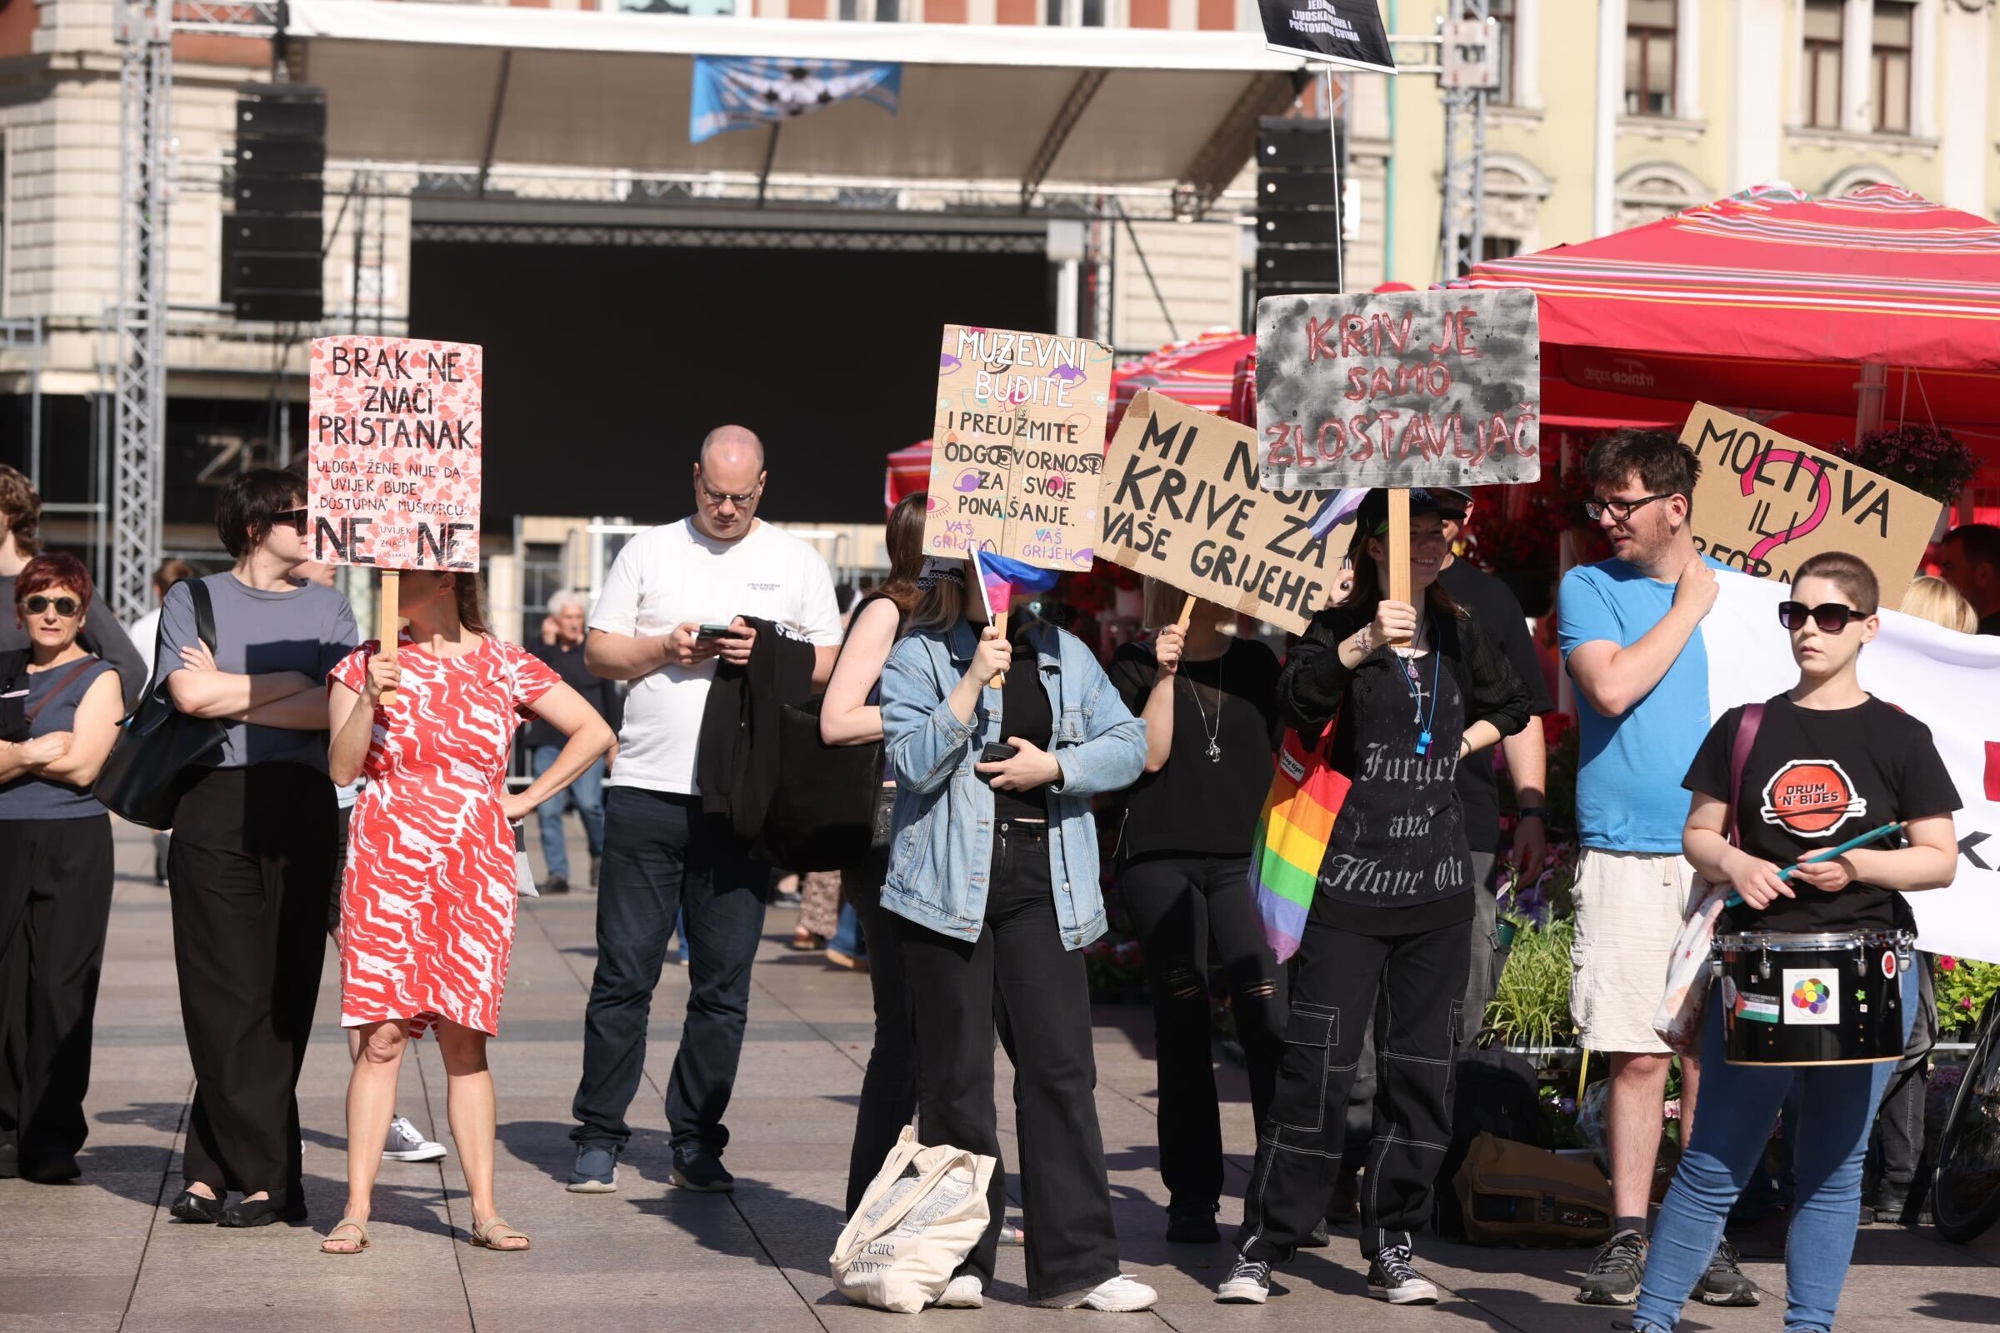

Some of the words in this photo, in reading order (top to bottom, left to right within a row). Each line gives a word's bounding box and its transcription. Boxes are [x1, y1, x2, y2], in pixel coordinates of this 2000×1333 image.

[956, 328, 1087, 371] MUŽEVNI
[1306, 310, 1413, 362] KRIV
[1429, 306, 1482, 358] JE
[332, 346, 413, 380] BRAK
[428, 352, 464, 383] NE
[1344, 359, 1453, 401] SAMO
[363, 382, 433, 415] ZNAČI
[975, 370, 1075, 408] BUDITE
[318, 415, 475, 450] PRISTANAK
[948, 411, 954, 430] I
[1138, 410, 1199, 466] MI
[1265, 401, 1537, 468] ZLOSTAVLJAČ
[316, 460, 358, 474] ULOGA
[366, 459, 399, 475] ŽENE
[409, 463, 436, 479] NIJE
[444, 466, 462, 479] DA
[330, 479, 374, 492] UVIJEK
[384, 481, 418, 496] BUDE
[977, 471, 1004, 491] ZA
[1024, 476, 1077, 500] SVOJE
[1694, 418, 1889, 539] MOLITVA
[945, 519, 973, 536] VAŠ
[958, 495, 1075, 527] PONAŠANJE.
[1112, 454, 1256, 541] KRIVE
[1265, 514, 1329, 569] ZA
[1748, 499, 1799, 544] ILI
[315, 516, 376, 564] NE
[380, 526, 411, 535] UVIJEK
[417, 522, 475, 569] NE
[1022, 544, 1073, 560] GRIJEH
[1035, 528, 1062, 545] VAŠ
[1102, 506, 1172, 562] VAŠE
[1190, 539, 1323, 621] GRIJEHE
[1360, 742, 1460, 790] Forget
[1786, 783, 1826, 795] DRUM
[1800, 792, 1839, 805] BIJES
[1389, 805, 1435, 838] and
[1324, 854, 1424, 896] Move
[1435, 856, 1463, 891] On
